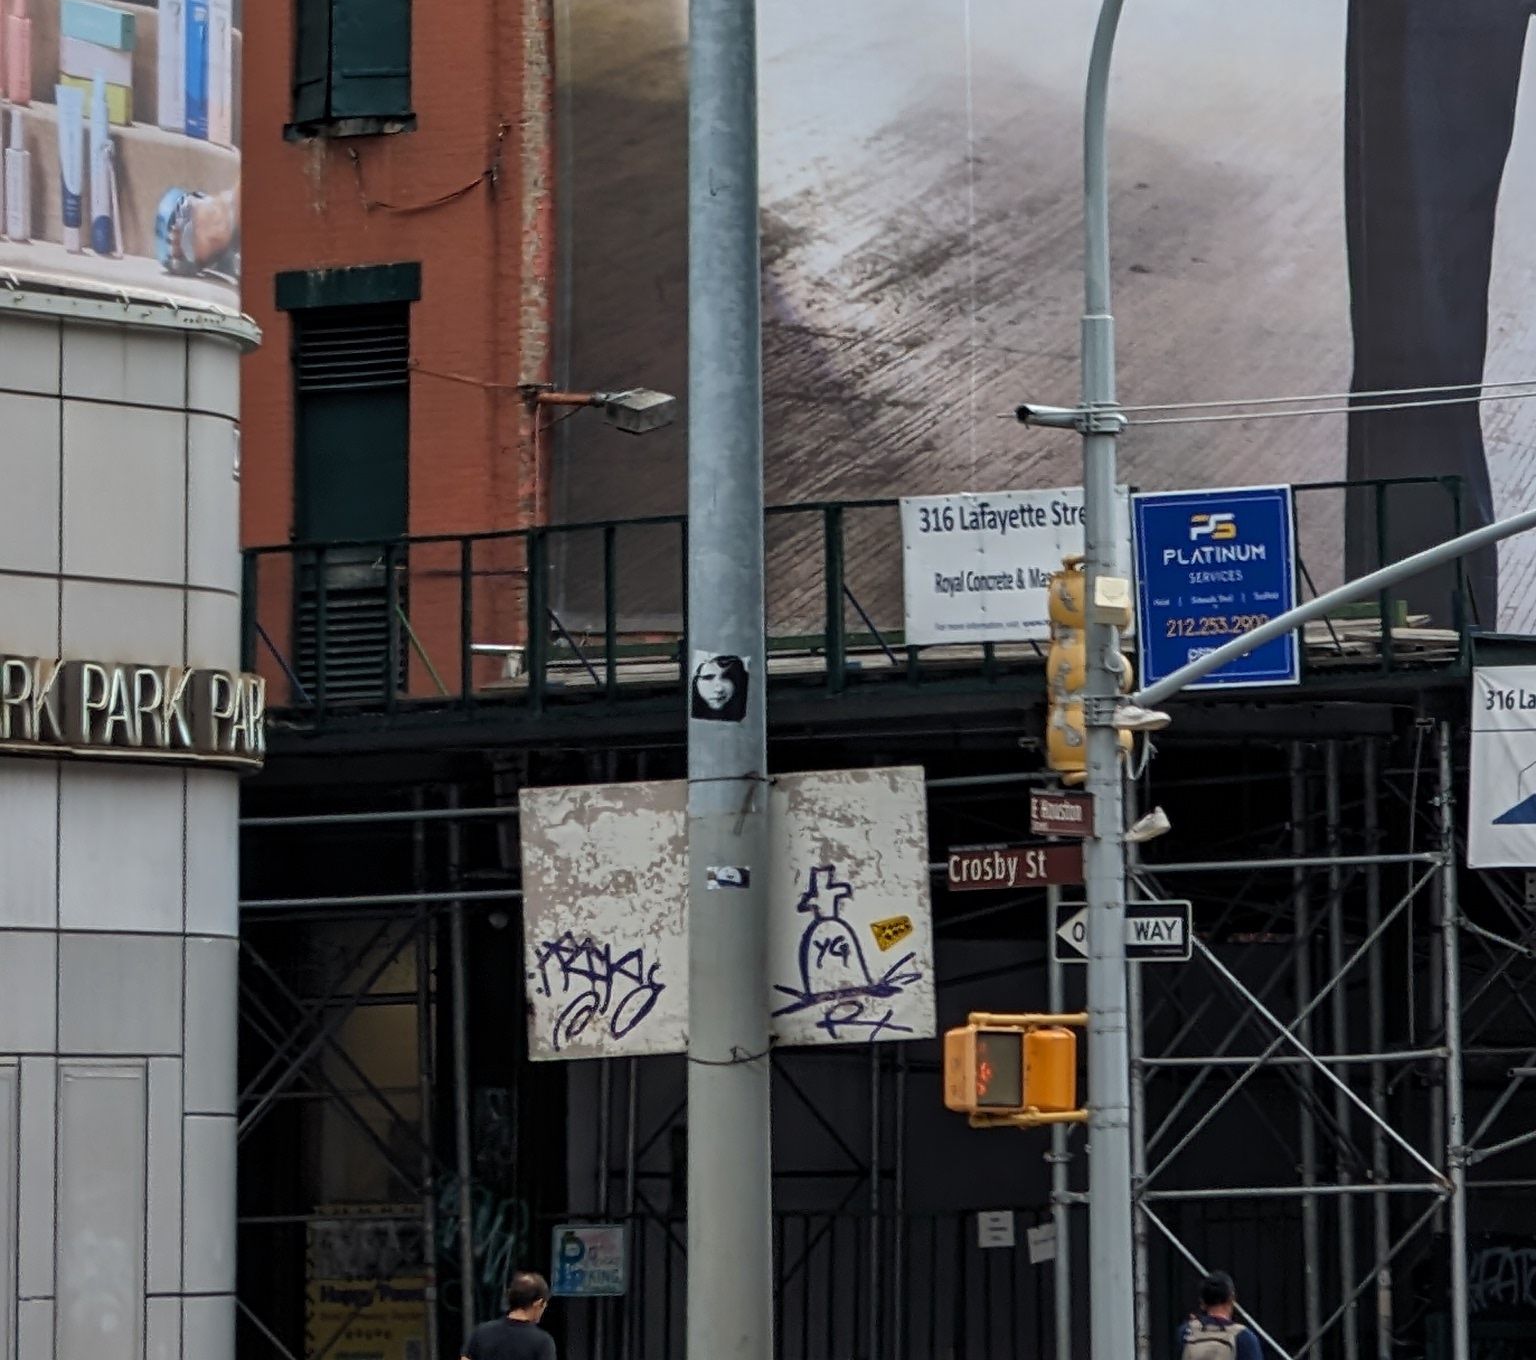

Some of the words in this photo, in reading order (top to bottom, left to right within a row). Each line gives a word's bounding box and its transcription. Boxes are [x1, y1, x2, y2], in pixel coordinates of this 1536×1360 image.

[919, 506, 955, 533] 316
[959, 502, 1047, 535] Lafayette
[1163, 544, 1267, 566] PLATINUM
[934, 569, 964, 597] Royal
[966, 569, 1014, 592] Concrete
[1016, 567, 1026, 589] &
[1188, 569, 1243, 585] SERVICES
[83, 663, 194, 748] PARK
[1486, 689, 1515, 711] 316
[1040, 798, 1082, 821] Houston
[949, 850, 1019, 887] Crosby
[1026, 849, 1048, 879] St
[1133, 920, 1178, 942] WAY
